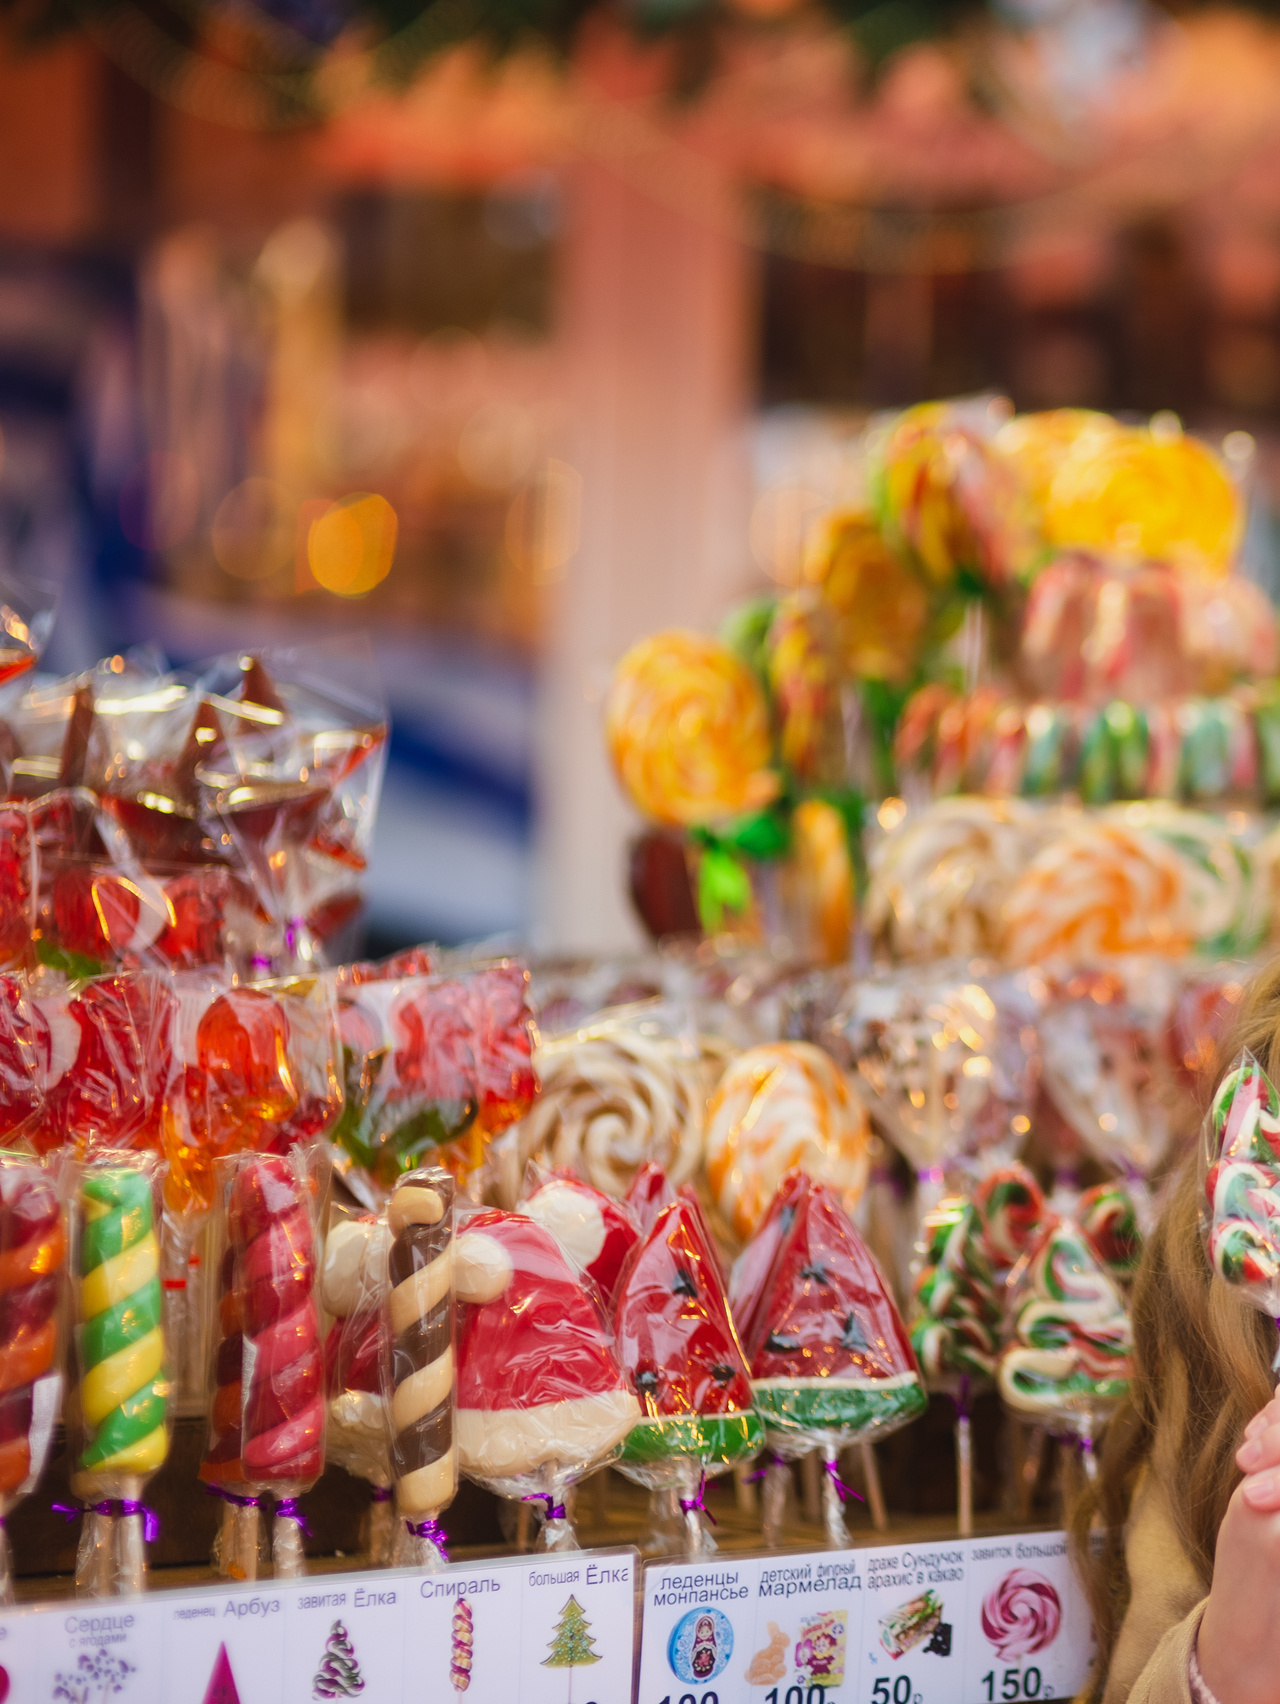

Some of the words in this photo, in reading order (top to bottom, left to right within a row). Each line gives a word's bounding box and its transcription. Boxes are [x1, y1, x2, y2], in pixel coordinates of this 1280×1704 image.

[528, 1570, 580, 1587] большая
[660, 1571, 739, 1591] леденцы
[761, 1563, 811, 1583] детский
[867, 1572, 913, 1591] арахис
[917, 1571, 924, 1584] в
[928, 1567, 964, 1583] какао
[420, 1578, 501, 1600] Спираль
[653, 1586, 749, 1606] монпансье
[758, 1575, 862, 1598] мармелад
[223, 1597, 280, 1620] Арбуз
[297, 1593, 346, 1610] завитая
[354, 1588, 397, 1608] Ёлка
[64, 1614, 135, 1636] Сердце
[79, 1633, 127, 1647] ягодами
